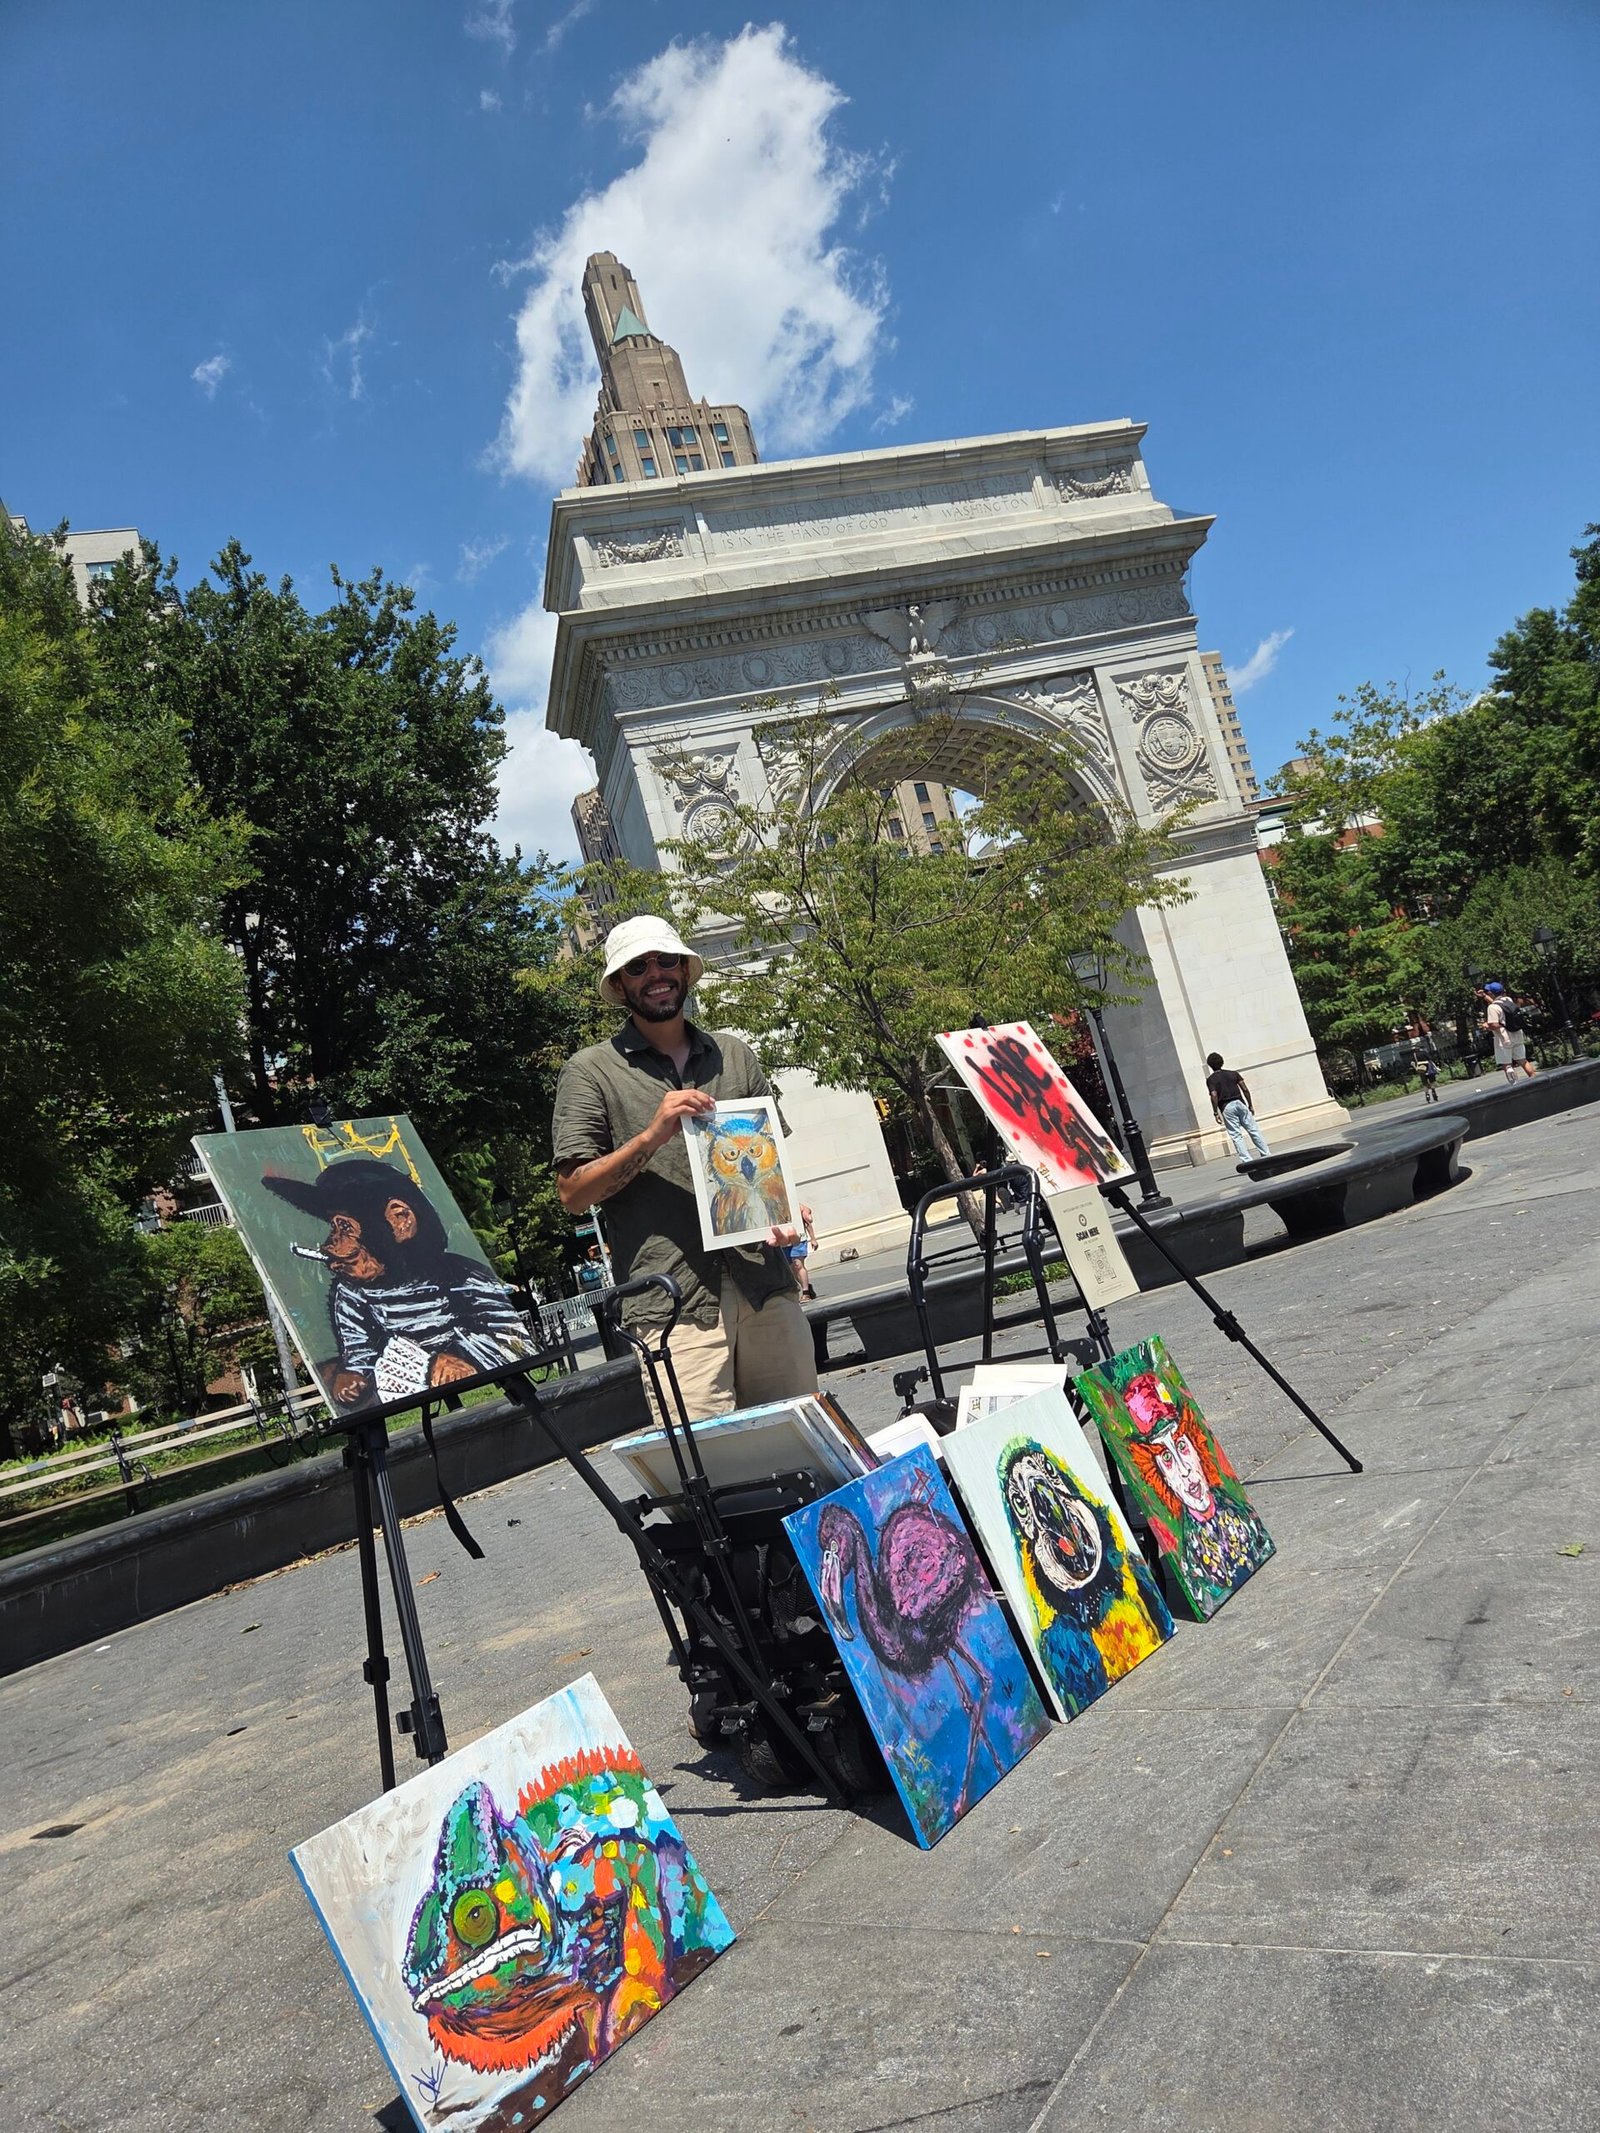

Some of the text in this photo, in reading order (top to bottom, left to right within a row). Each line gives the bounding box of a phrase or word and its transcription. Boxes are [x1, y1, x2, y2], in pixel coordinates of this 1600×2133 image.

[721, 497, 1029, 550] IS IN THE HAND OF GOD WASHINGTON
[1076, 1230, 1089, 1241] SCAN
[1088, 1226, 1100, 1237] HERE
